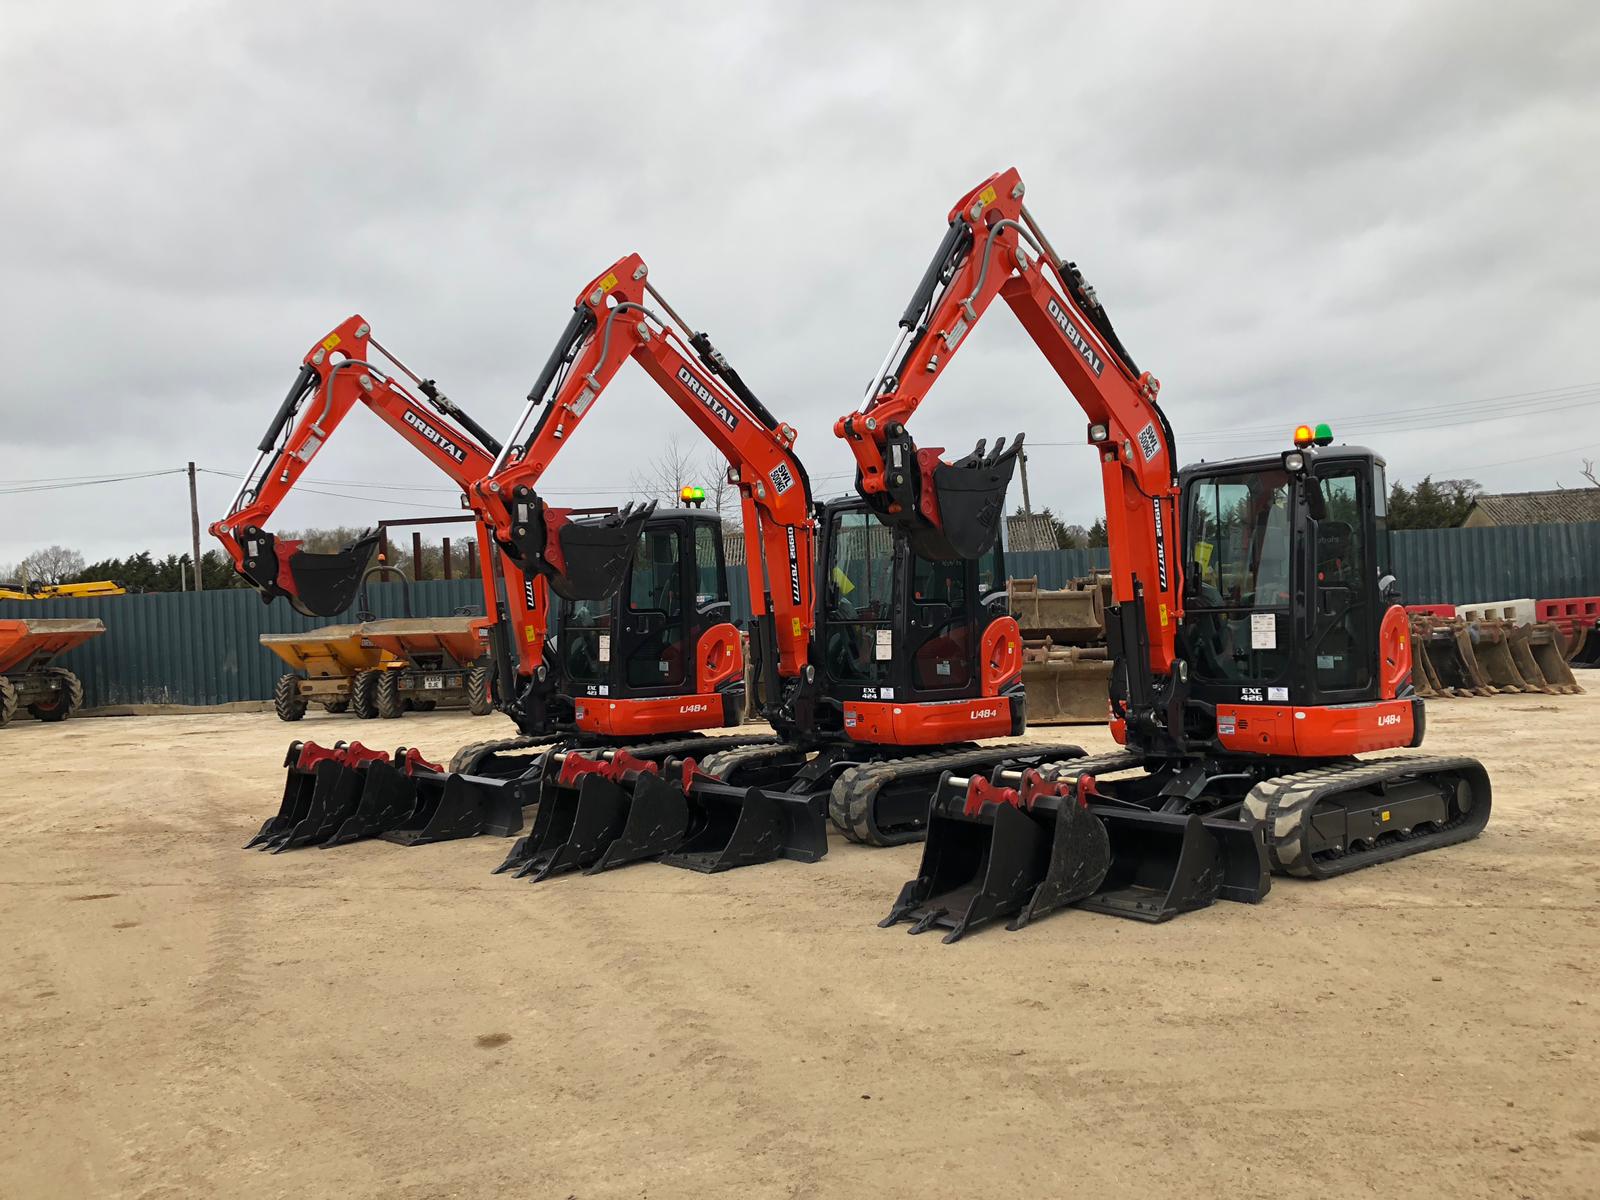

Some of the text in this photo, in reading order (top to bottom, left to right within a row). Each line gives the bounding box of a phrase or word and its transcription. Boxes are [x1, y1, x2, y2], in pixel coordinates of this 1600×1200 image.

[1048, 299, 1100, 375] ORBITAL
[678, 367, 735, 429] ORBITAL
[403, 410, 463, 462] ORBITAL
[1139, 431, 1153, 458] 500KG
[1146, 425, 1158, 452] SWL
[770, 469, 786, 492] 500KG
[778, 464, 791, 487] SWL
[1153, 499, 1167, 588] 01992 787777
[787, 526, 800, 602] 01992 787777
[1240, 694, 1263, 702] 426
